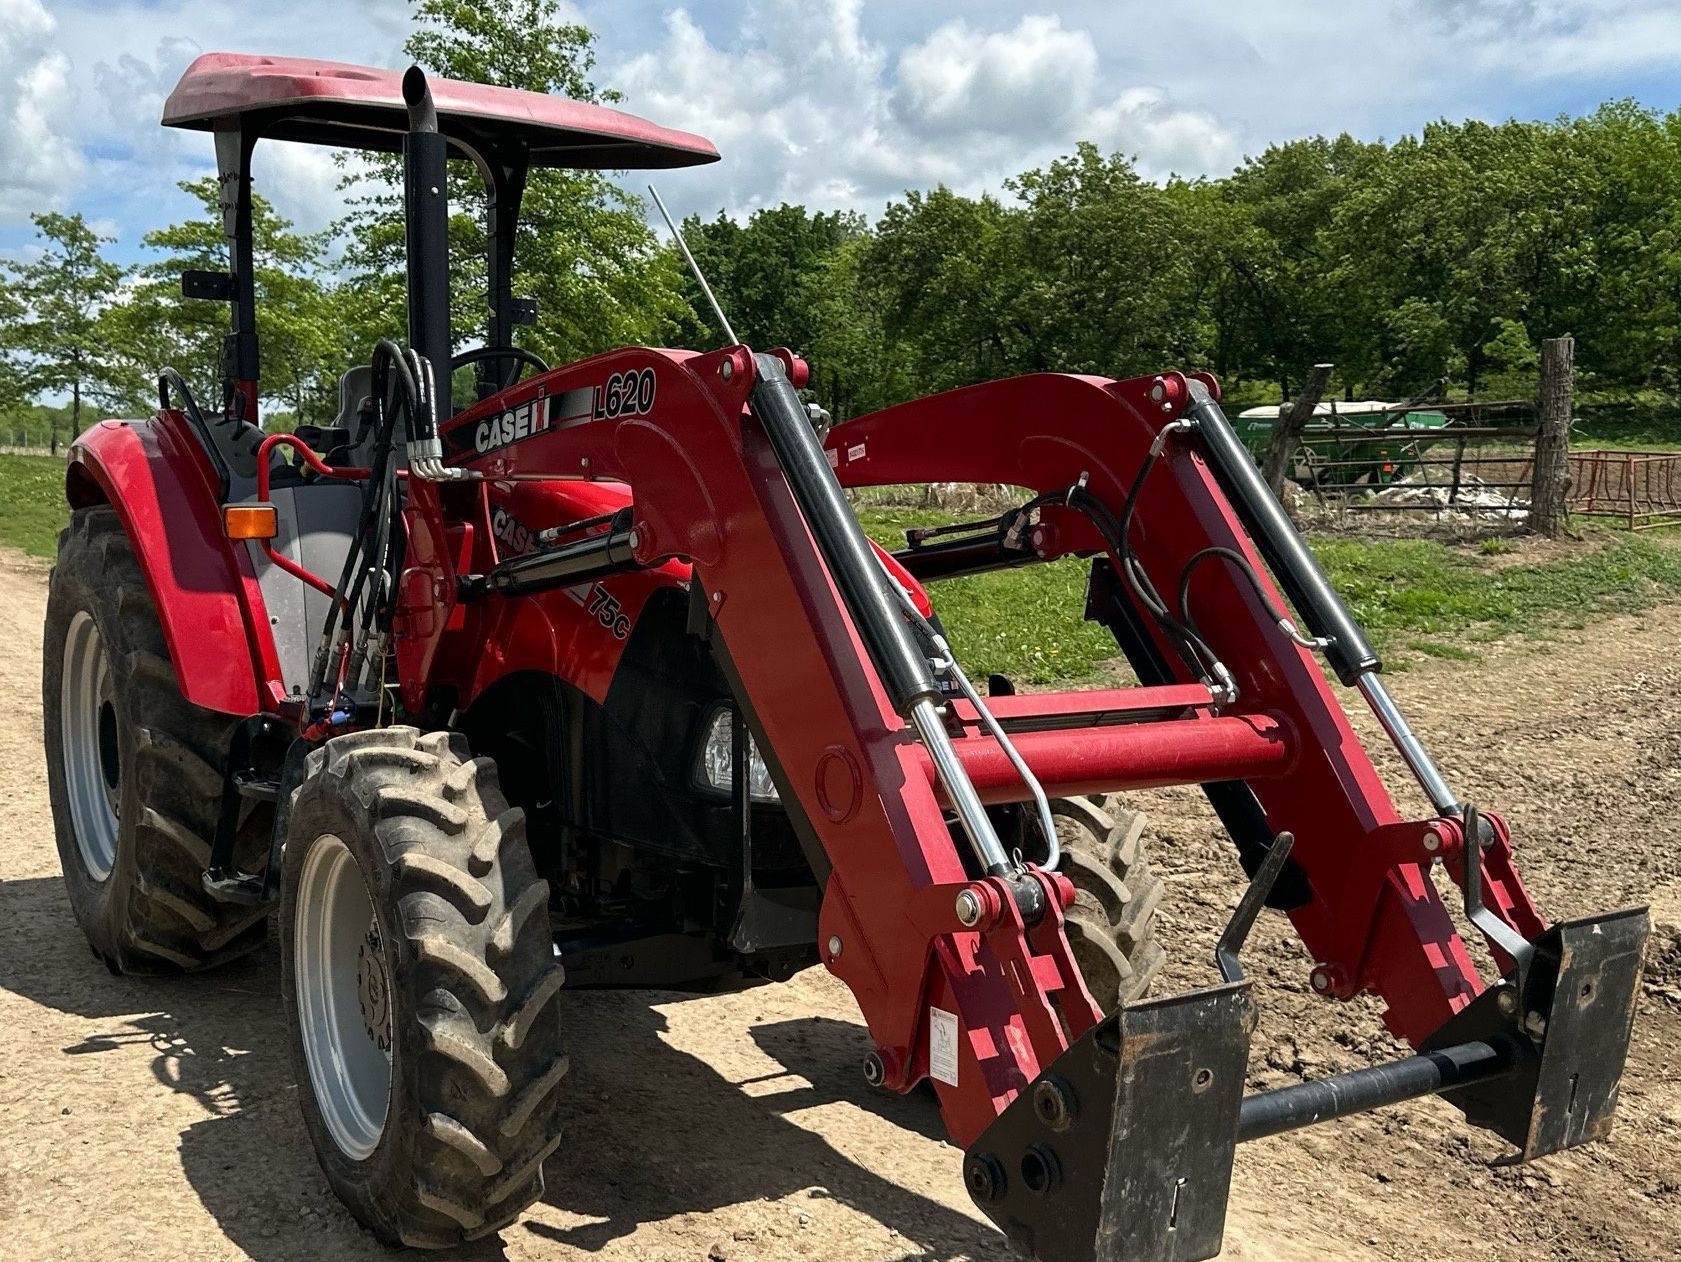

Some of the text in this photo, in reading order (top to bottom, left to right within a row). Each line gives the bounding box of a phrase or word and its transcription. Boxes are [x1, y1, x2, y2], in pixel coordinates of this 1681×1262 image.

[592, 367, 657, 421] L620
[475, 408, 529, 454] CASE
[588, 584, 632, 641] 75C
